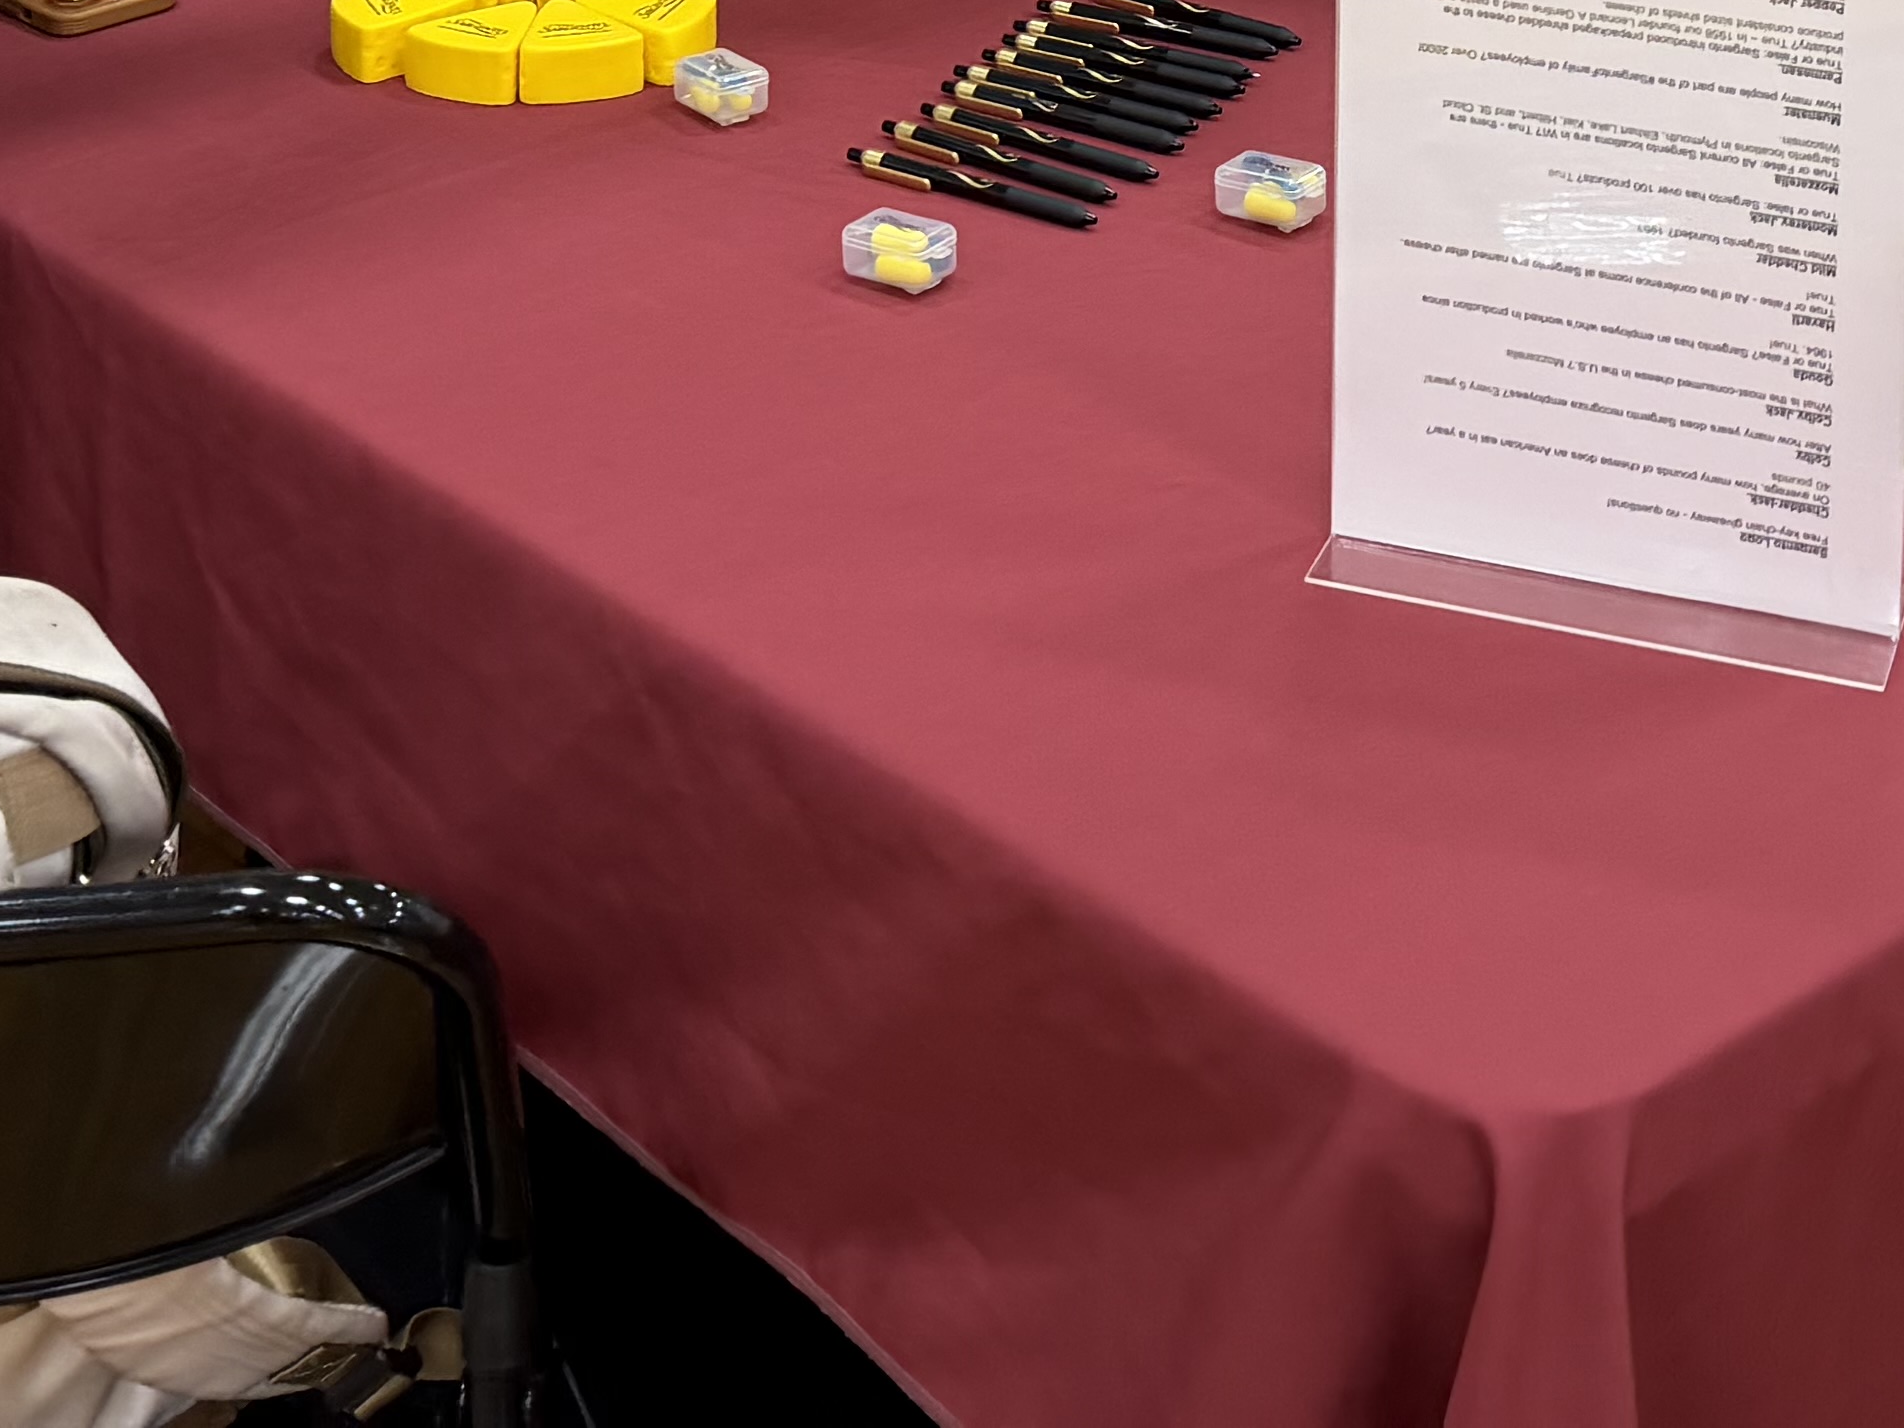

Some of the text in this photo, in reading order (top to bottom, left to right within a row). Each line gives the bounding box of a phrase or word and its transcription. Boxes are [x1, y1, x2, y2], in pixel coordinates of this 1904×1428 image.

[1476, 9, 1515, 25] cheese
[1518, 15, 1568, 32] shredded
[1588, 11, 1634, 28] Leonard
[1637, 18, 1680, 34] founder
[1646, 33, 1705, 51] introduced
[1708, 39, 1759, 59] Sargento
[1761, 35, 1787, 48] True
[1816, 57, 1842, 70] True
[1692, 78, 1714, 93] part
[1739, 85, 1777, 103] people
[1781, 91, 1812, 105] many
[1815, 98, 1841, 111] How
[1507, 121, 1532, 135] True
[1587, 118, 1617, 134] Lake,
[1594, 135, 1643, 152] locations
[1646, 140, 1696, 160] Sargento
[1734, 142, 1784, 159] locations
[1700, 151, 1739, 165] current
[1787, 147, 1839, 167] Sargento
[1548, 168, 1573, 181] True
[1576, 170, 1630, 190] products?
[1813, 168, 1839, 181] True
[1633, 181, 1653, 194] 100
[1657, 185, 1682, 196] over
[1708, 190, 1759, 210] Sargento
[1749, 211, 1838, 235] Monterey Jack
[1812, 208, 1838, 222] True
[1668, 227, 1837, 263] When Sargento founded?
[1756, 254, 1836, 277] Mild Cheddar
[1471, 249, 1835, 318] True False conference Sargento named
[1453, 297, 1833, 373] True False? Sargento employee worked production
[1567, 359, 1597, 373] U.S.?
[1634, 370, 1674, 386] cheese
[1793, 368, 1833, 385] Gouda
[1469, 379, 1499, 396] Every
[1677, 377, 1766, 402] most-consumed
[1803, 398, 1832, 413] What
[1626, 407, 1675, 427] Sargento
[1765, 404, 1831, 425] Colby Jack
[1680, 418, 1706, 433] does
[1710, 421, 1740, 436] years
[1743, 427, 1774, 442] many
[1426, 422, 1731, 486] many pounds cheese does American year?
[1805, 440, 1831, 454] After
[1795, 448, 1830, 466] Colby
[1771, 469, 1812, 489] pounds
[1746, 519, 1799, 540] key-chain
[1803, 531, 1828, 545] Free
[1771, 536, 1828, 557] Sargento
